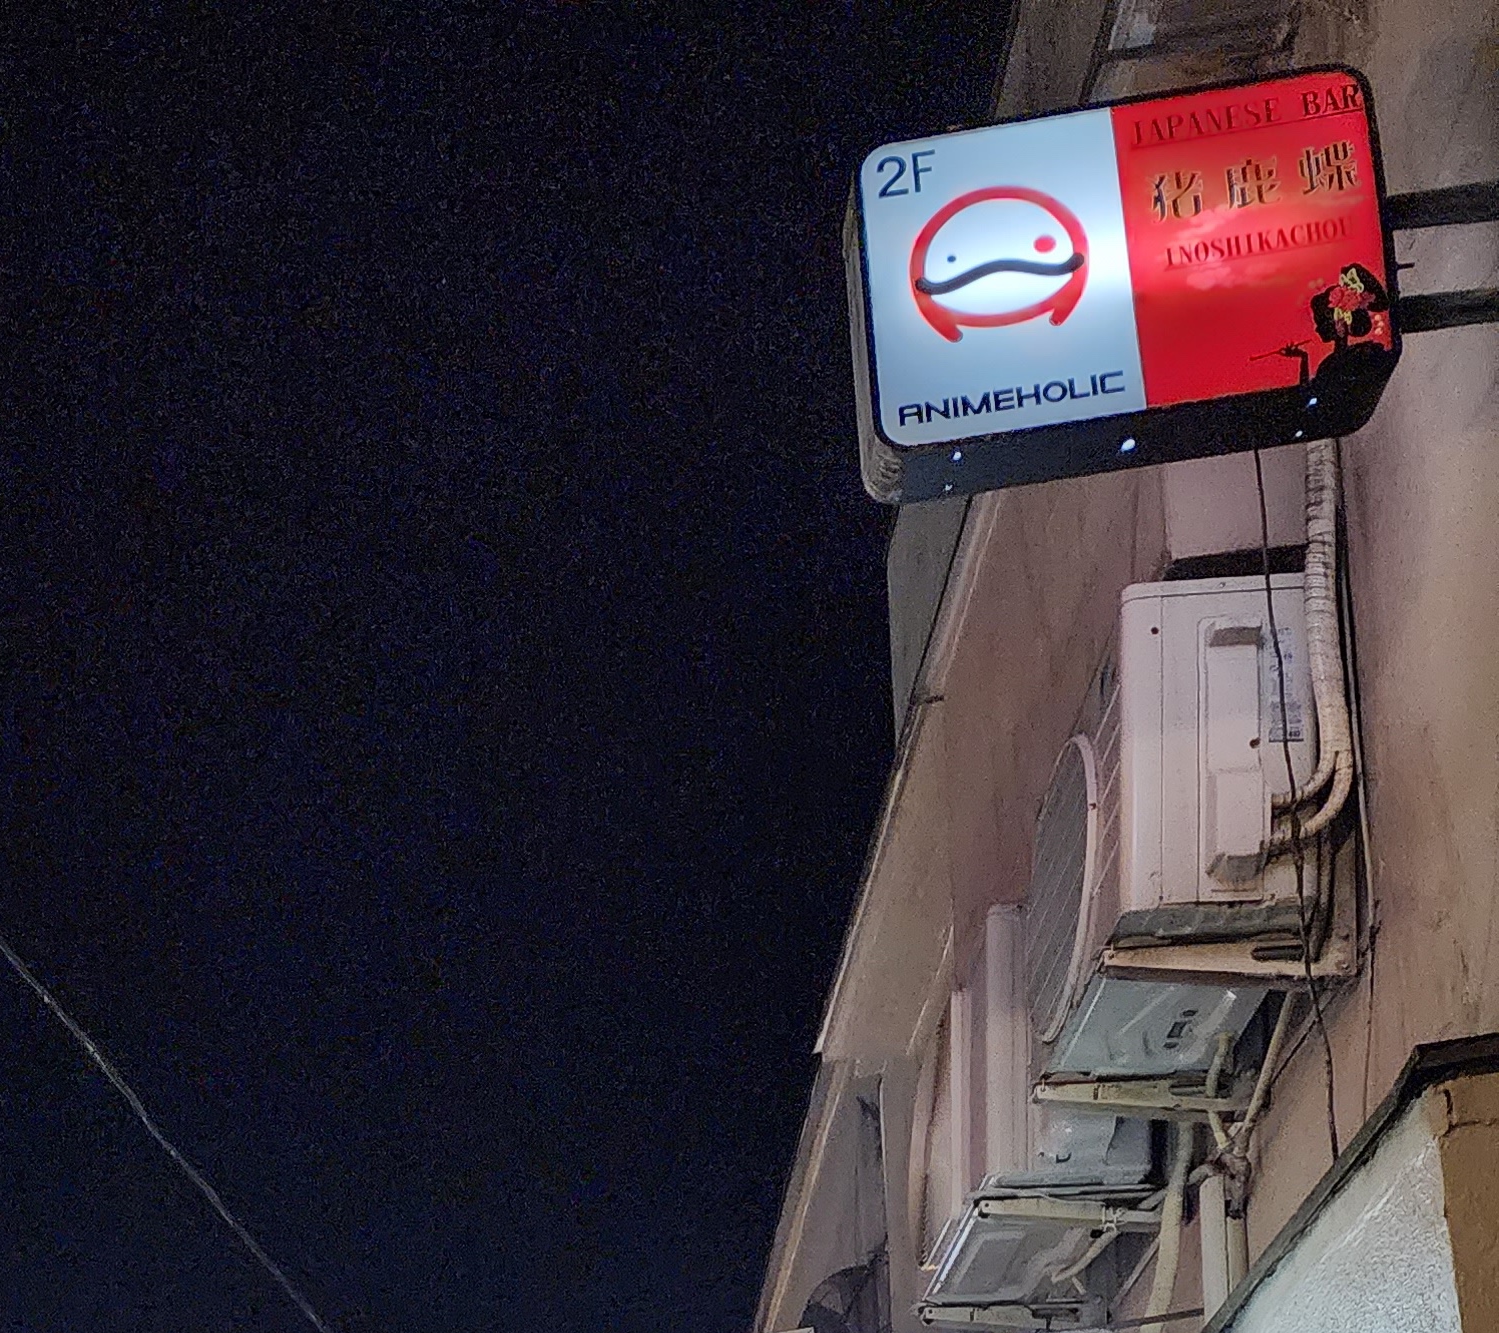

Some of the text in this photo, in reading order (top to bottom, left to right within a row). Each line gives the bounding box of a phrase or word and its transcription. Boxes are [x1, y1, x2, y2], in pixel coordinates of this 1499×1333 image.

[1132, 83, 1363, 146] JAPANESE BAR
[876, 150, 935, 198] 2F
[1151, 139, 1361, 223] 猪鹿蝶
[1164, 216, 1353, 266] INOSHIKACHOU
[897, 370, 1126, 427] ANIMEHOLIC
